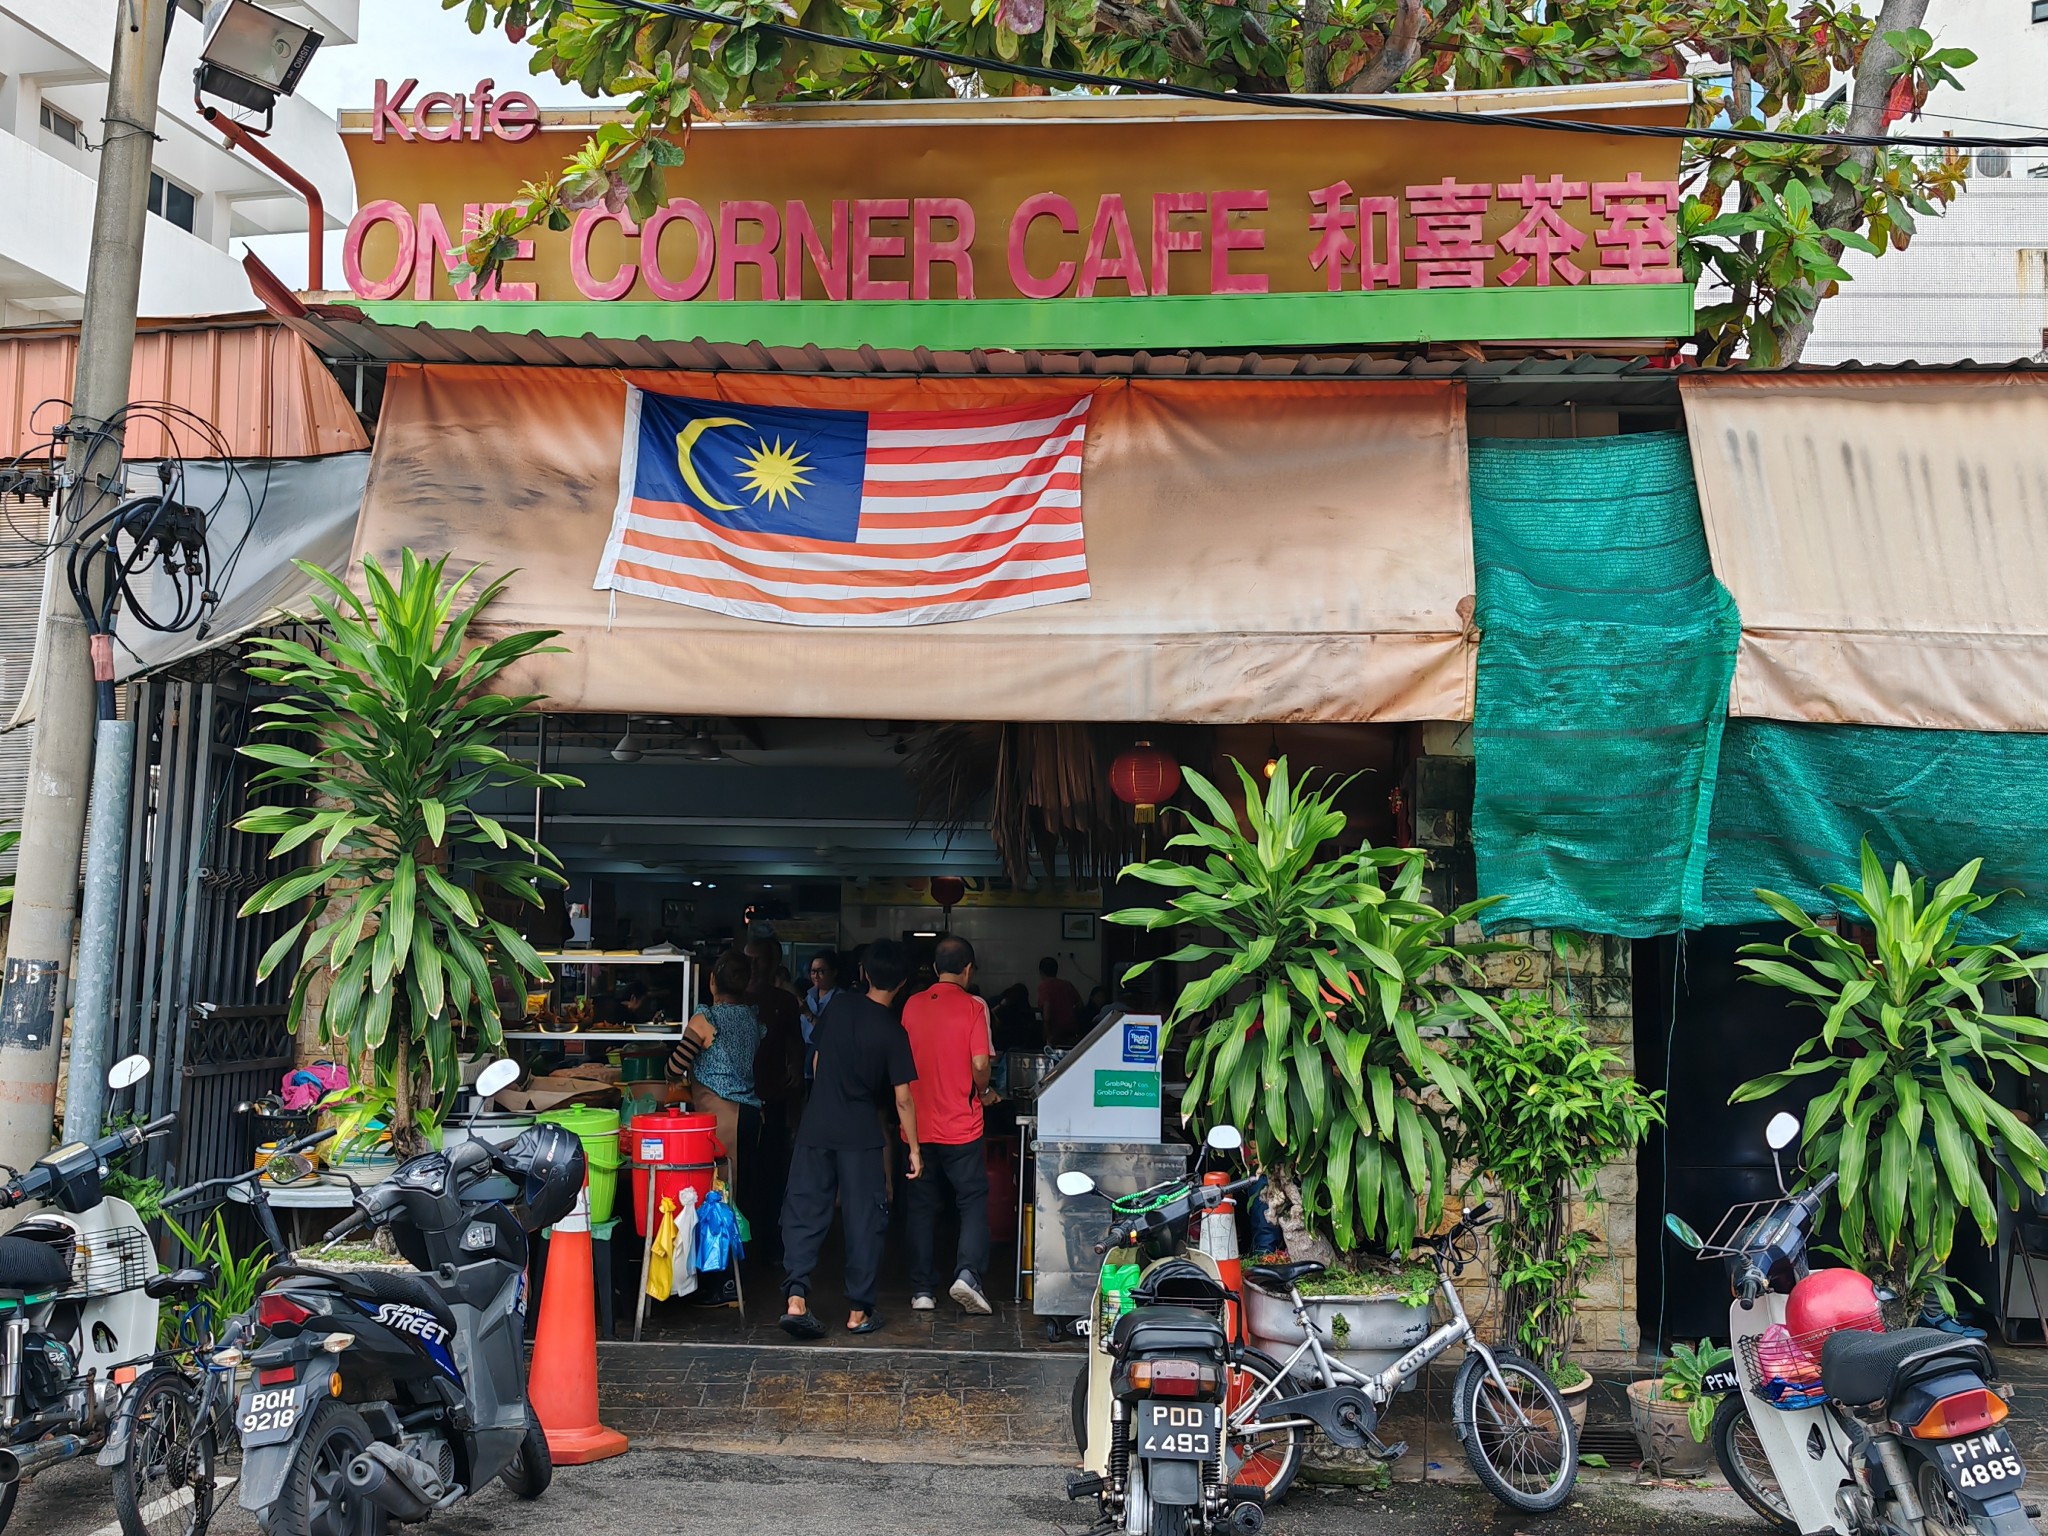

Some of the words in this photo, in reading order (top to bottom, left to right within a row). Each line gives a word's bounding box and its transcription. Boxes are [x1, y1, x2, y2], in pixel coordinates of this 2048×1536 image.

[293, 45, 312, 69] USHIO
[372, 78, 540, 143] Kafe
[342, 199, 538, 301] ONE
[570, 197, 976, 301] CORNER
[1007, 190, 1269, 299] CAFE
[1307, 172, 1684, 291] 和喜茶室
[1514, 954, 1533, 982] 2
[370, 1303, 449, 1346] STREET
[251, 1388, 295, 1412] BQH
[243, 1409, 295, 1433] 9218
[1960, 1456, 2020, 1488] 4885
